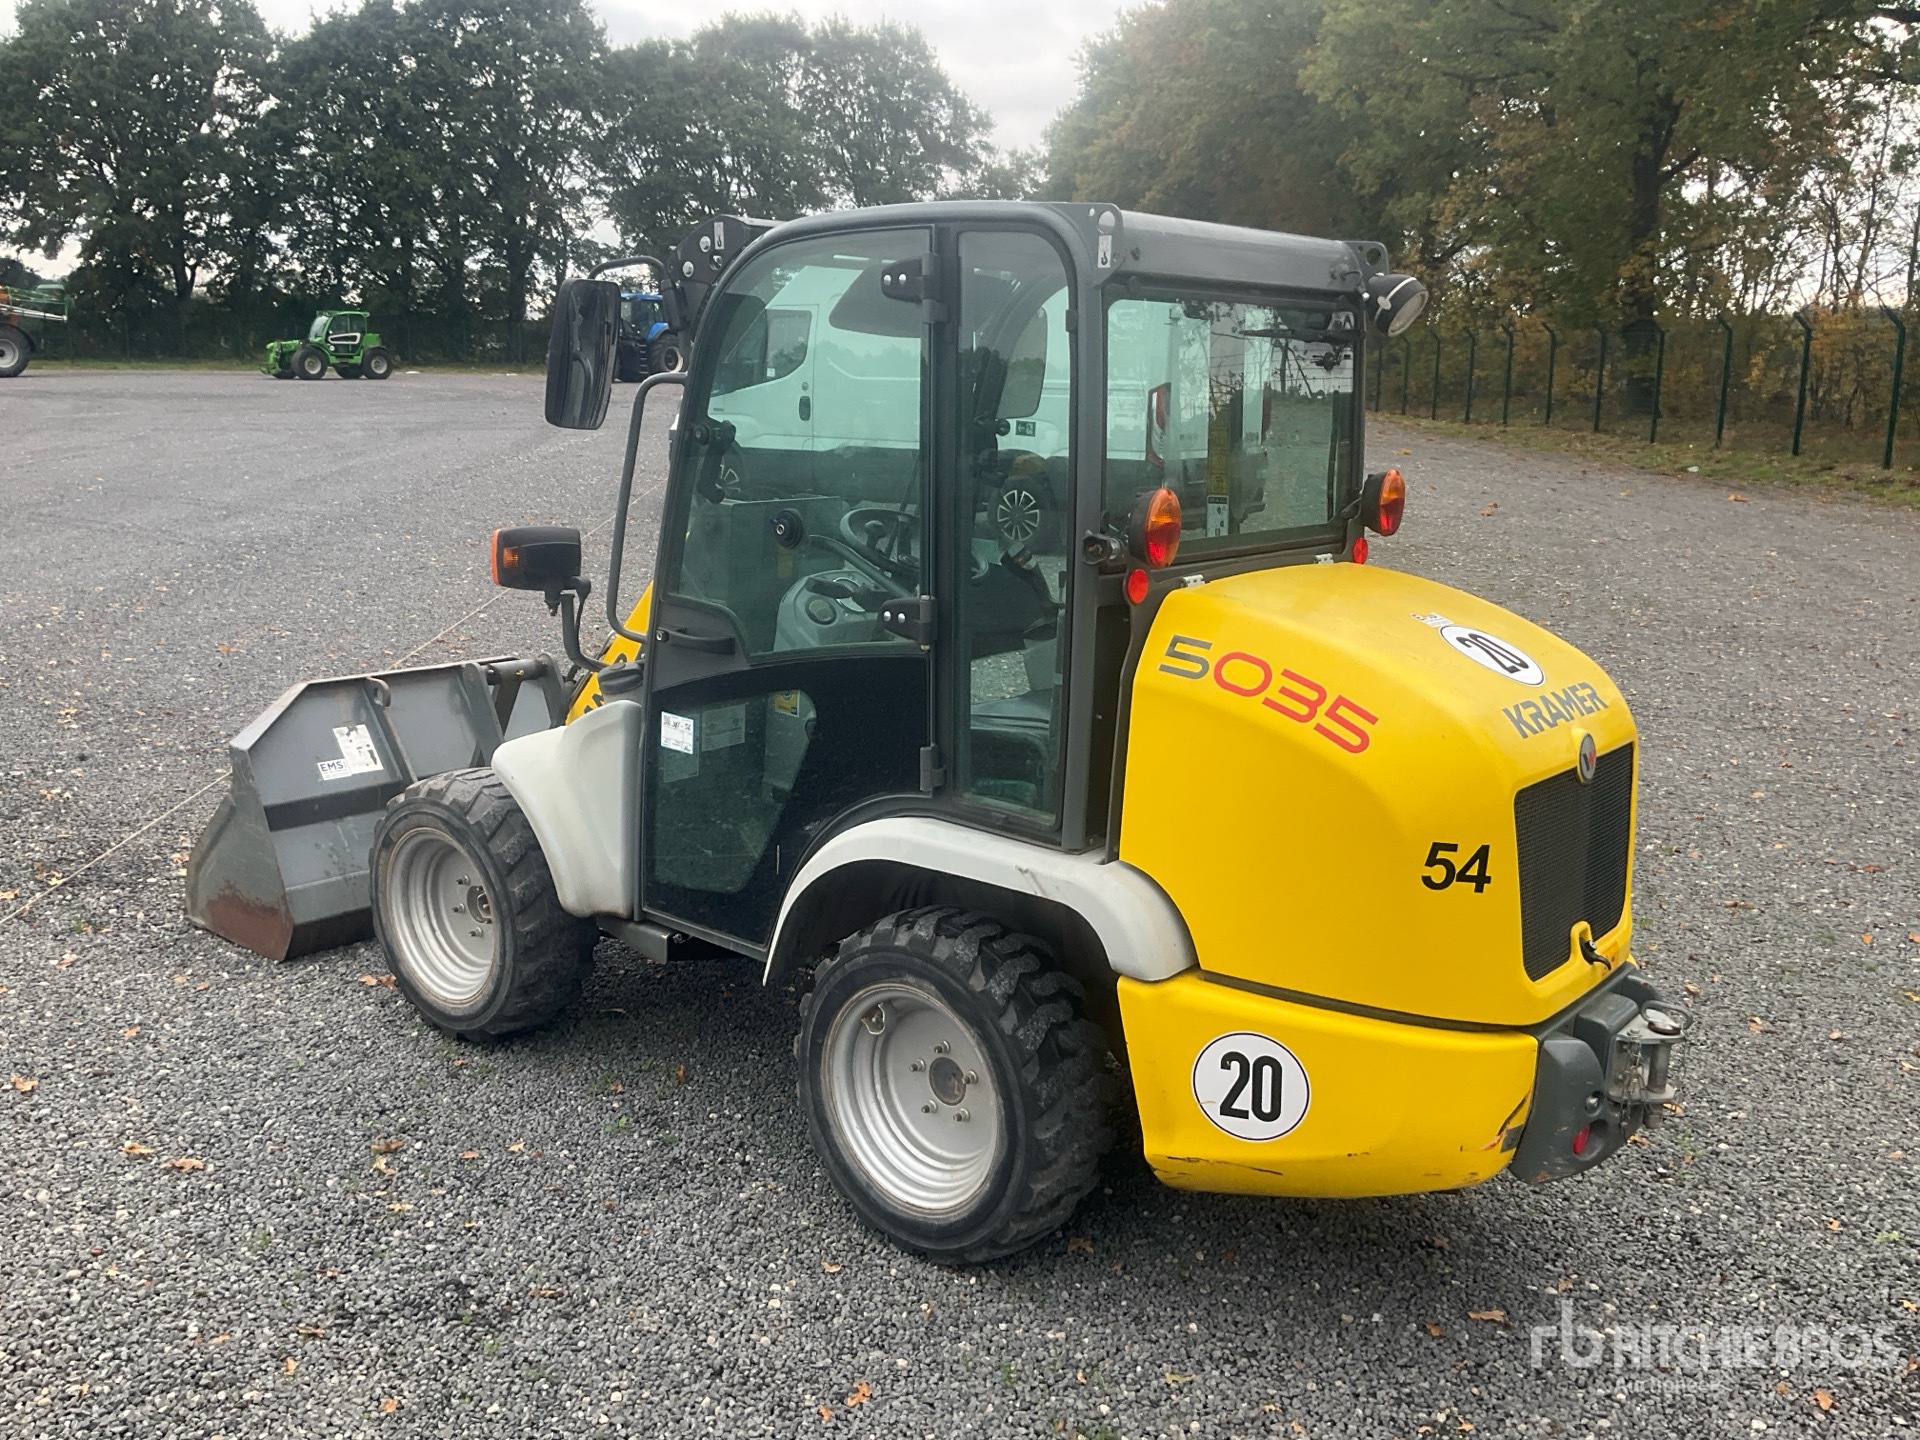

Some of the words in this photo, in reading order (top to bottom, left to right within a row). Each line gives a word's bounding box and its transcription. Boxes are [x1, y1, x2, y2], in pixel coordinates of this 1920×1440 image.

[1455, 632, 1530, 674] 20
[1158, 634, 1379, 754] 5035
[1502, 682, 1609, 740] KRAMER
[319, 761, 344, 772] EMS
[1421, 841, 1492, 893] 54
[1218, 1051, 1283, 1123] 20
